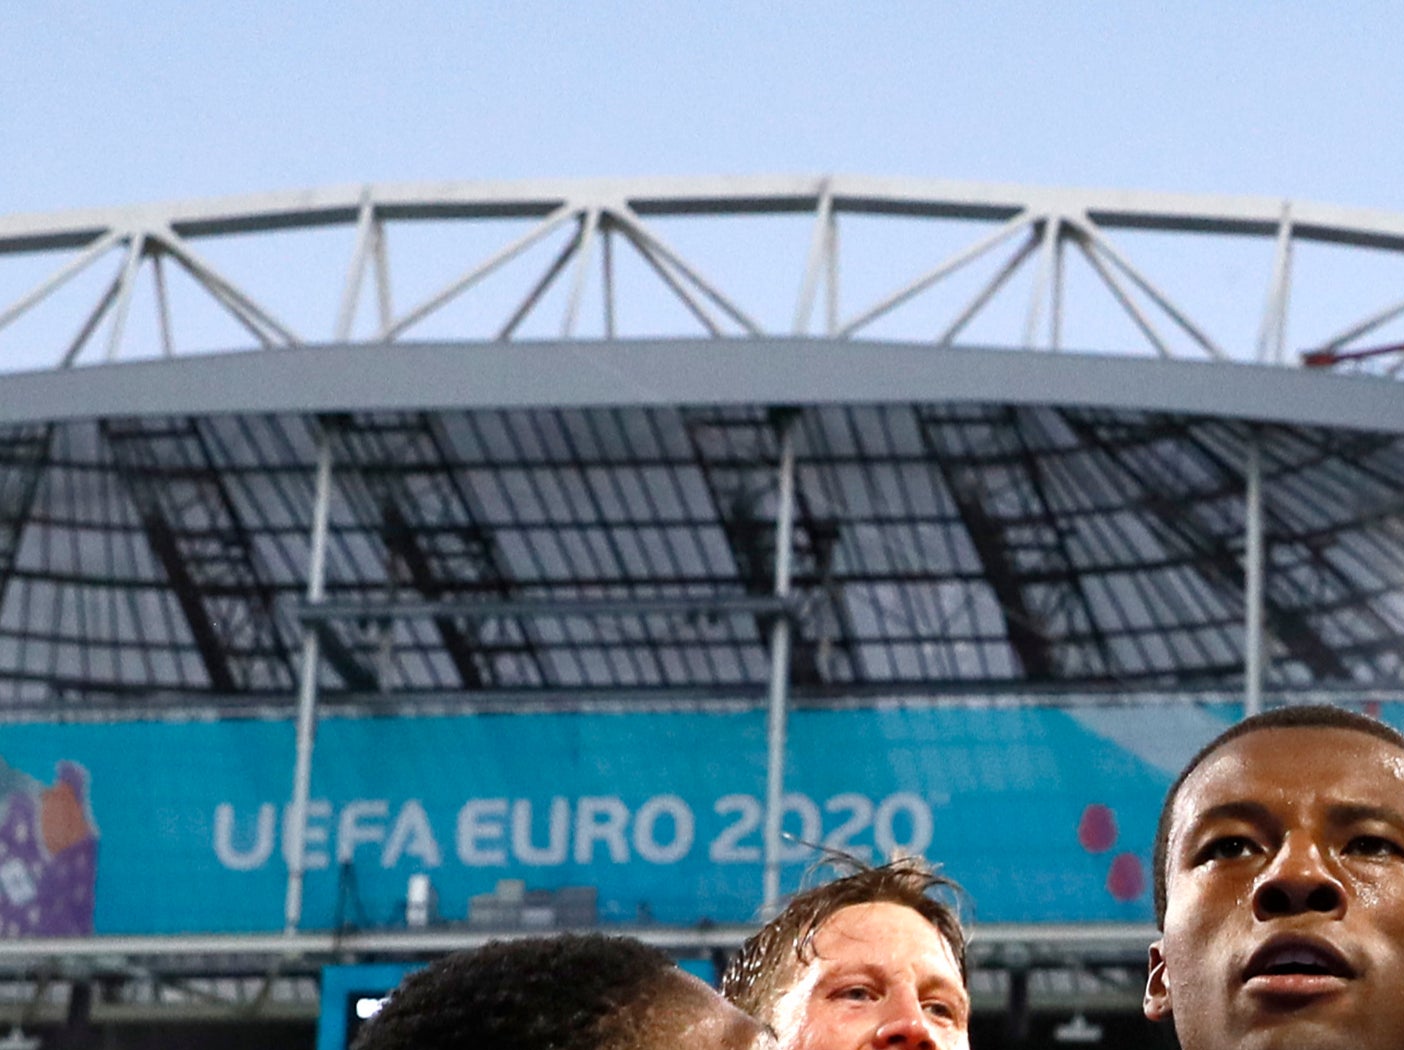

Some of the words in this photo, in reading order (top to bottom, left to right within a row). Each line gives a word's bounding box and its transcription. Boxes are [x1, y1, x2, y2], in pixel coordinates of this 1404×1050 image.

[213, 799, 443, 870] UEFA
[456, 794, 695, 866] EURO
[709, 792, 935, 863] 2020
